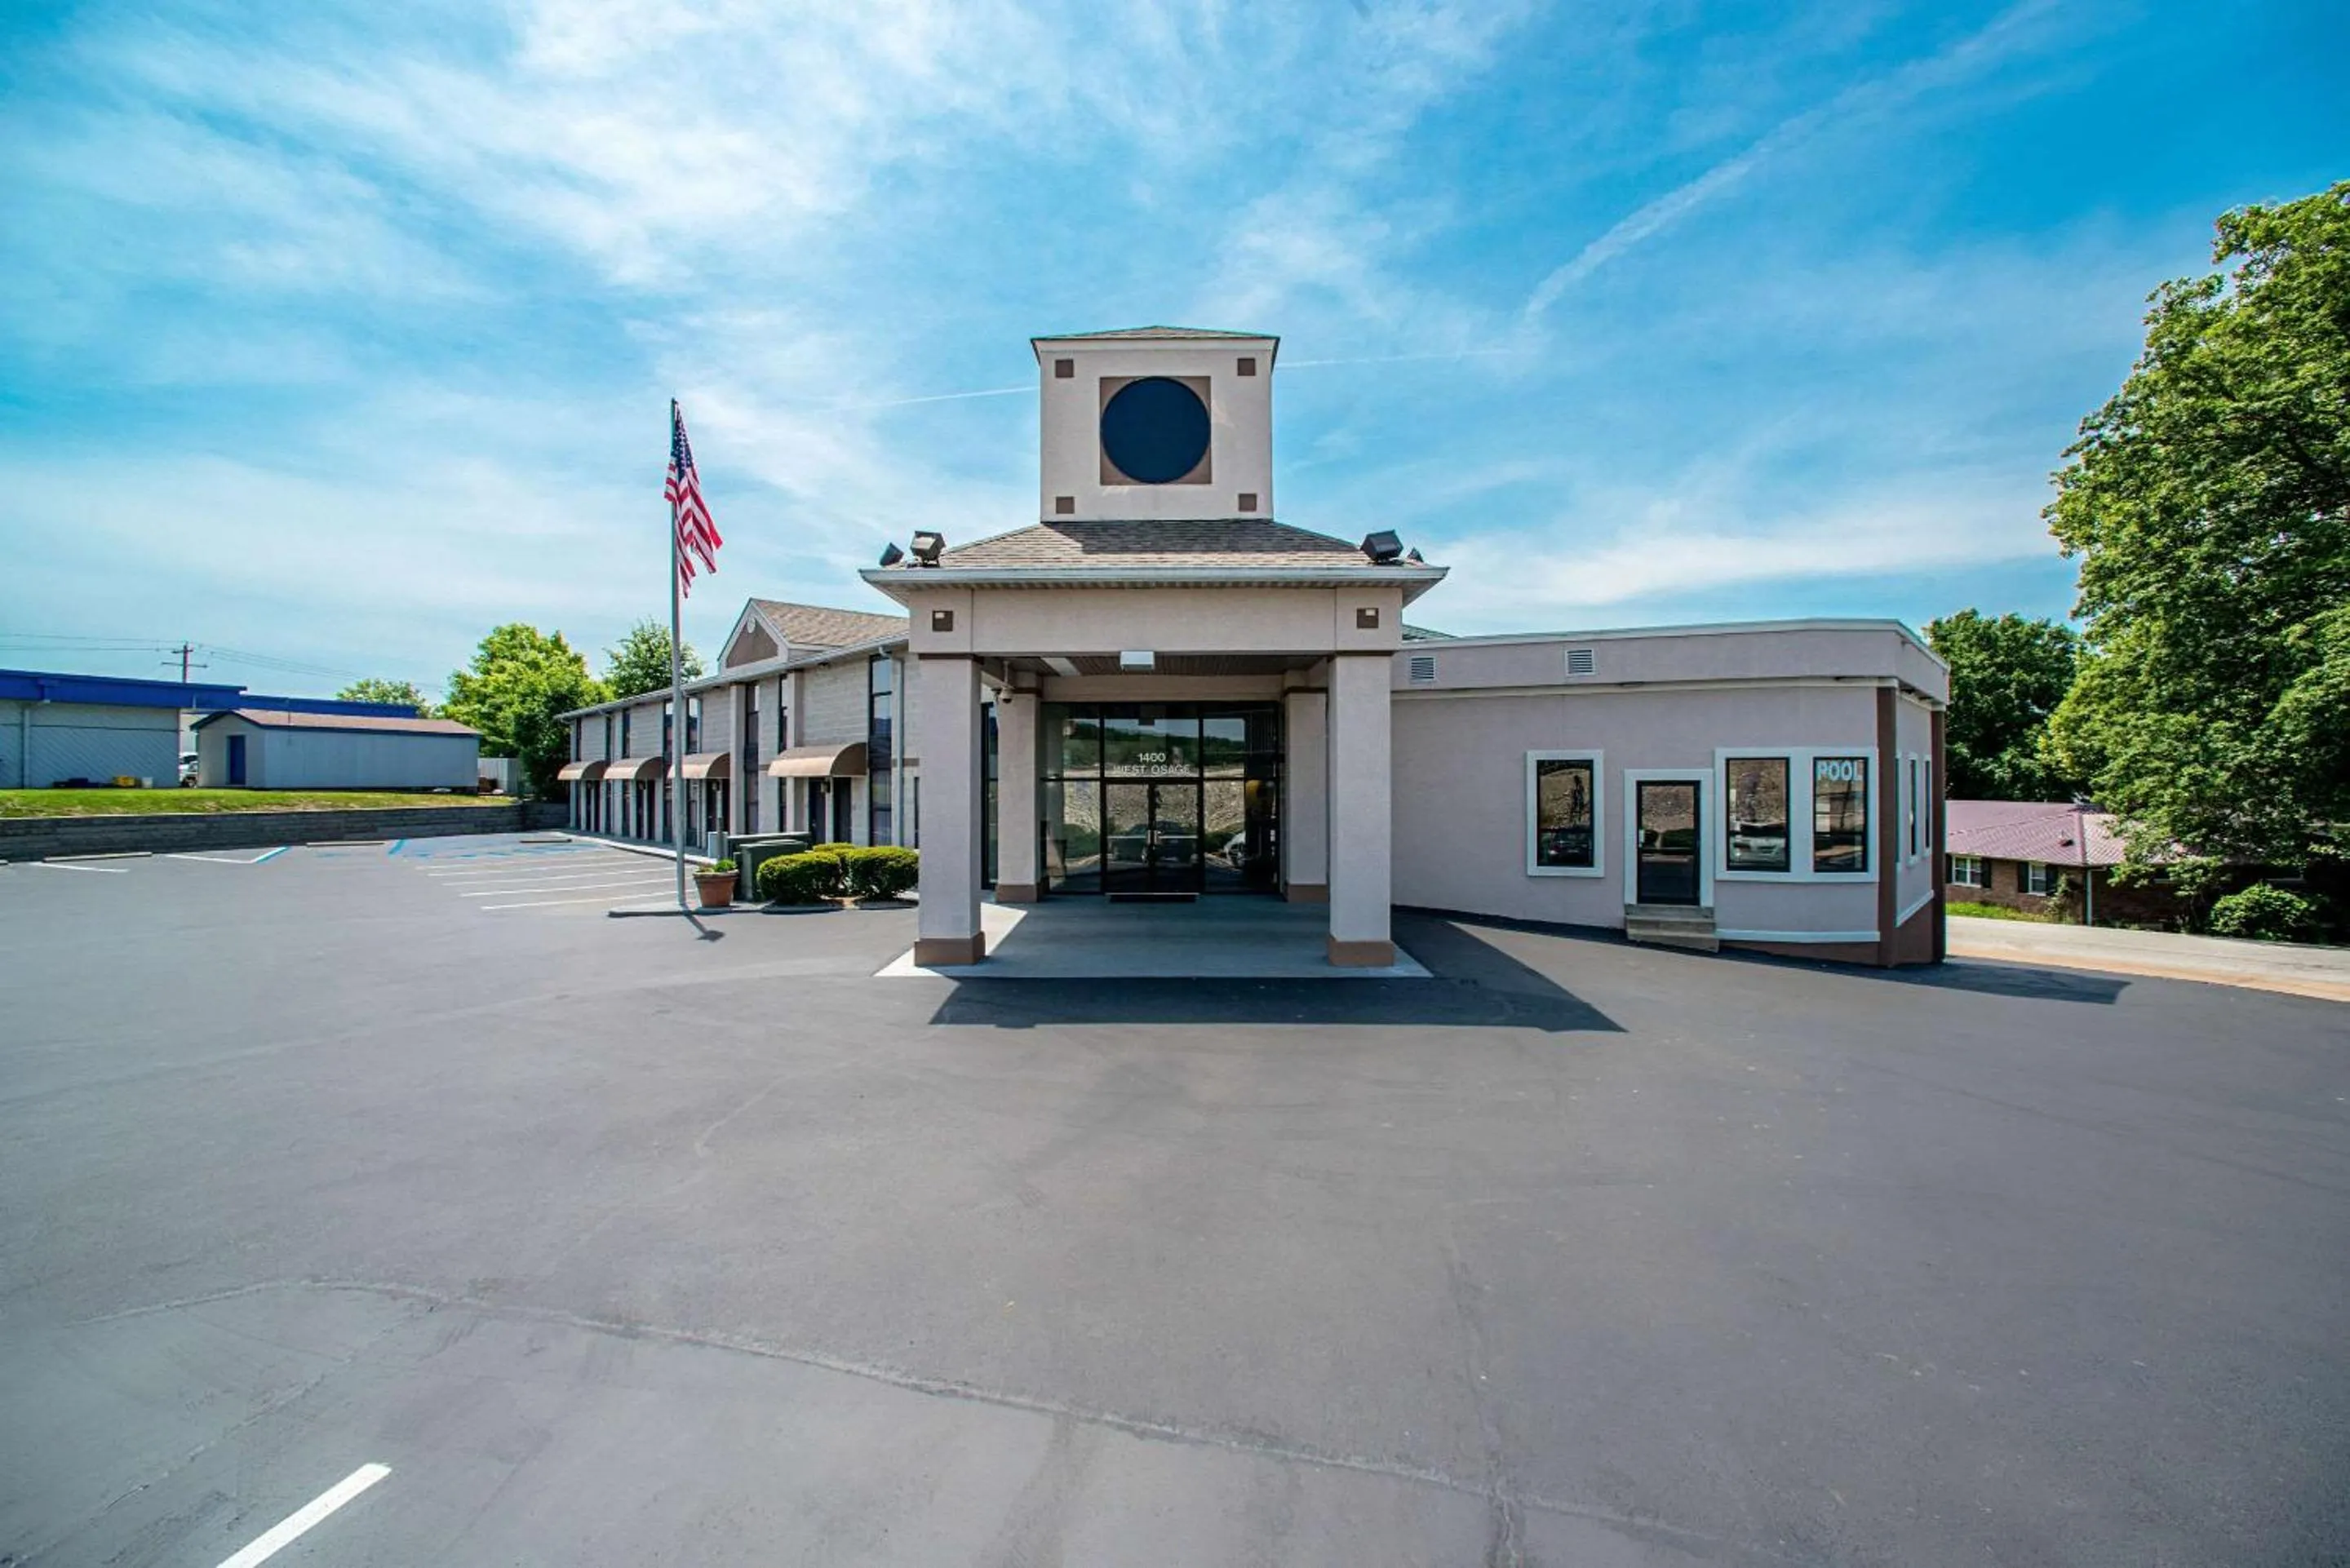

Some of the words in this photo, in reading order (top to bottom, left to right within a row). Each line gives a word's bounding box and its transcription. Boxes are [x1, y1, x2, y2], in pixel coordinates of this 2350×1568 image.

[1138, 752, 1166, 763] 1400
[1114, 764, 1146, 774] WEST
[1816, 760, 1864, 780] POOL
